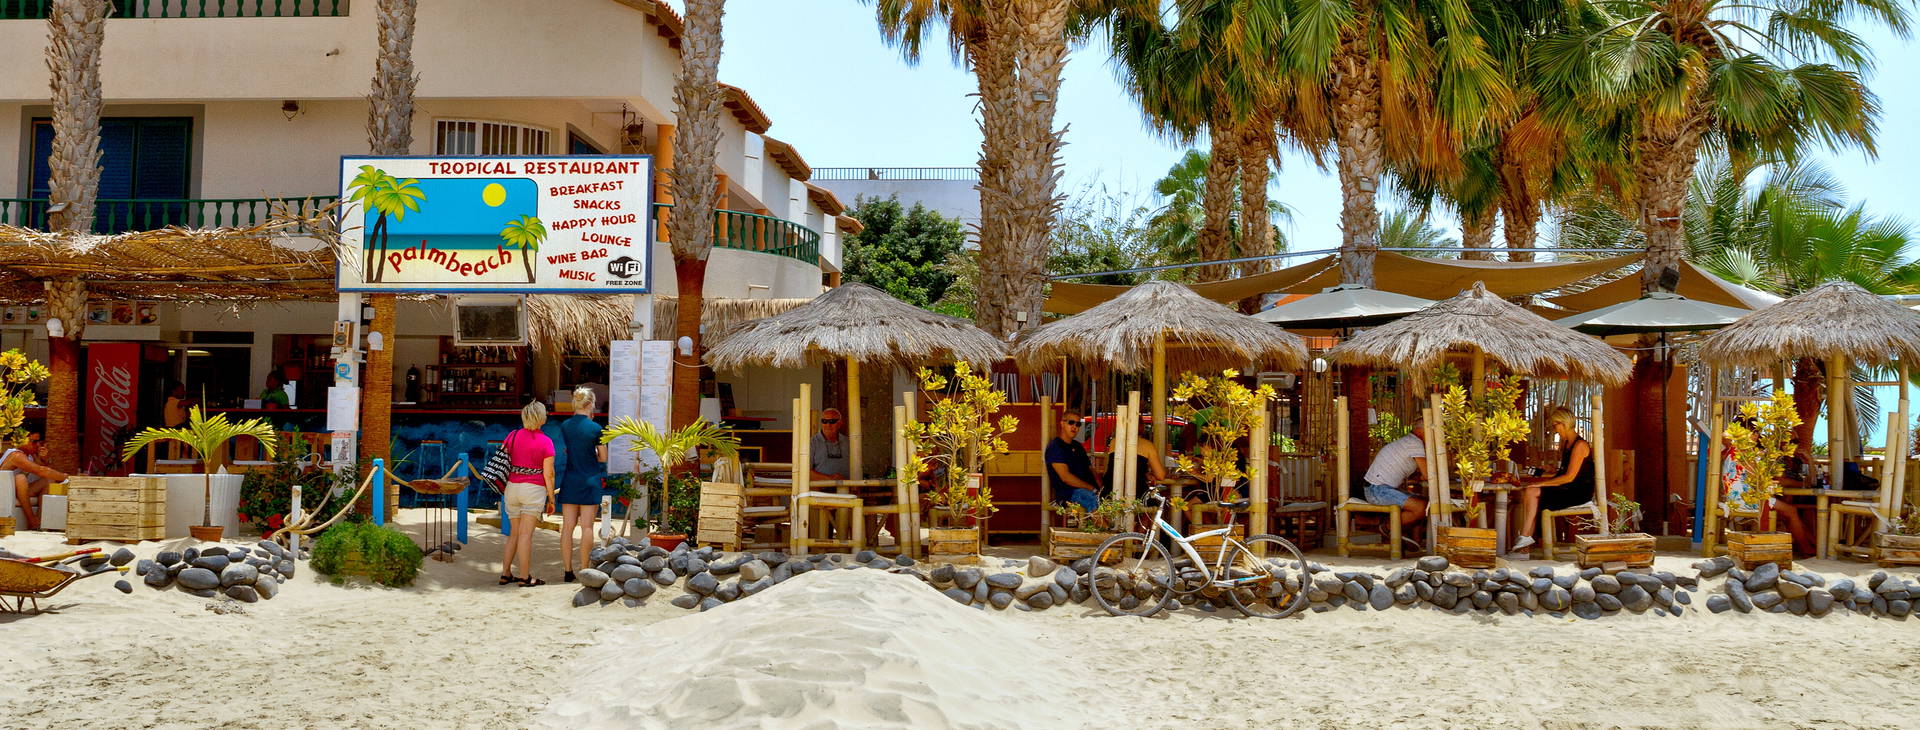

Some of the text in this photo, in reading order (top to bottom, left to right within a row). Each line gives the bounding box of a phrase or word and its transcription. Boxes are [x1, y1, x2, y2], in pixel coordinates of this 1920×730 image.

[429, 161, 640, 175] TROPICAL RESTAURANT
[549, 180, 624, 197] BREAKFAST
[573, 199, 622, 211] SNACKS
[551, 213, 637, 231] HAPPY HOUR
[581, 231, 632, 248] LOUNGE
[388, 239, 512, 276] palmbeach
[547, 247, 608, 265] WINE BAR
[559, 269, 597, 283] MUSIC
